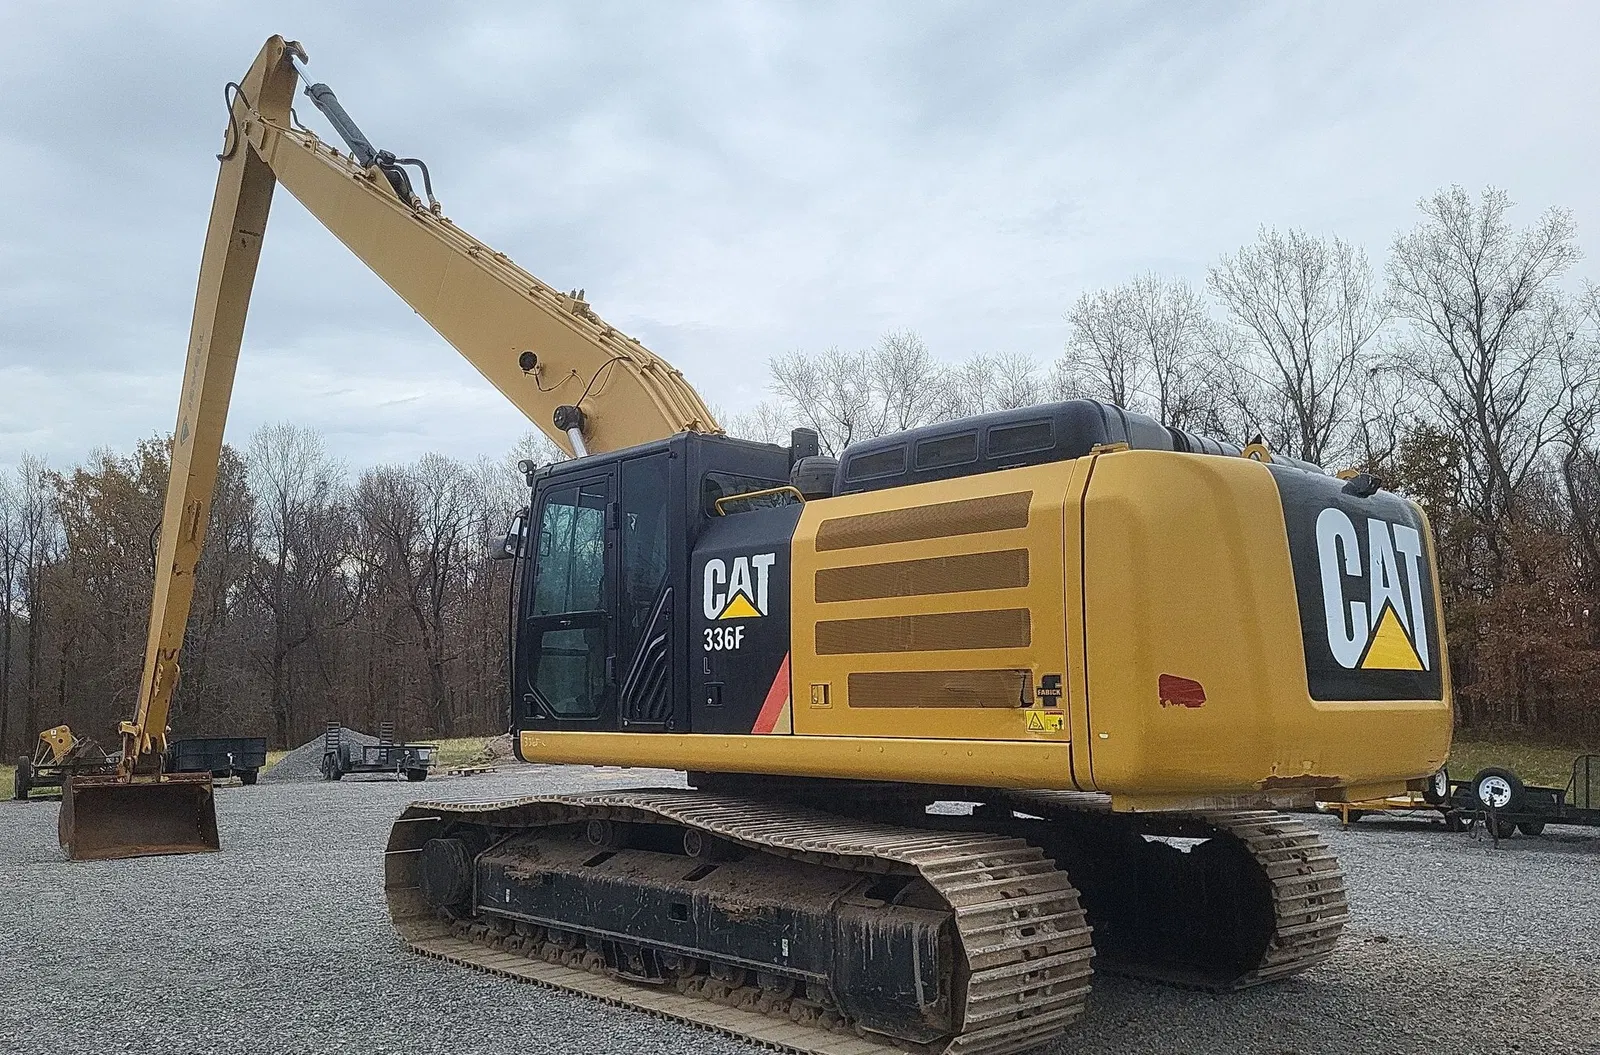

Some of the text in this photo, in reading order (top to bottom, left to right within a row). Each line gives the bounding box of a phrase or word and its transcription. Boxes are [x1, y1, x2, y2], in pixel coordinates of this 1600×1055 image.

[703, 552, 776, 620] CAT
[1316, 507, 1430, 671] CAT
[703, 625, 745, 652] 336F
